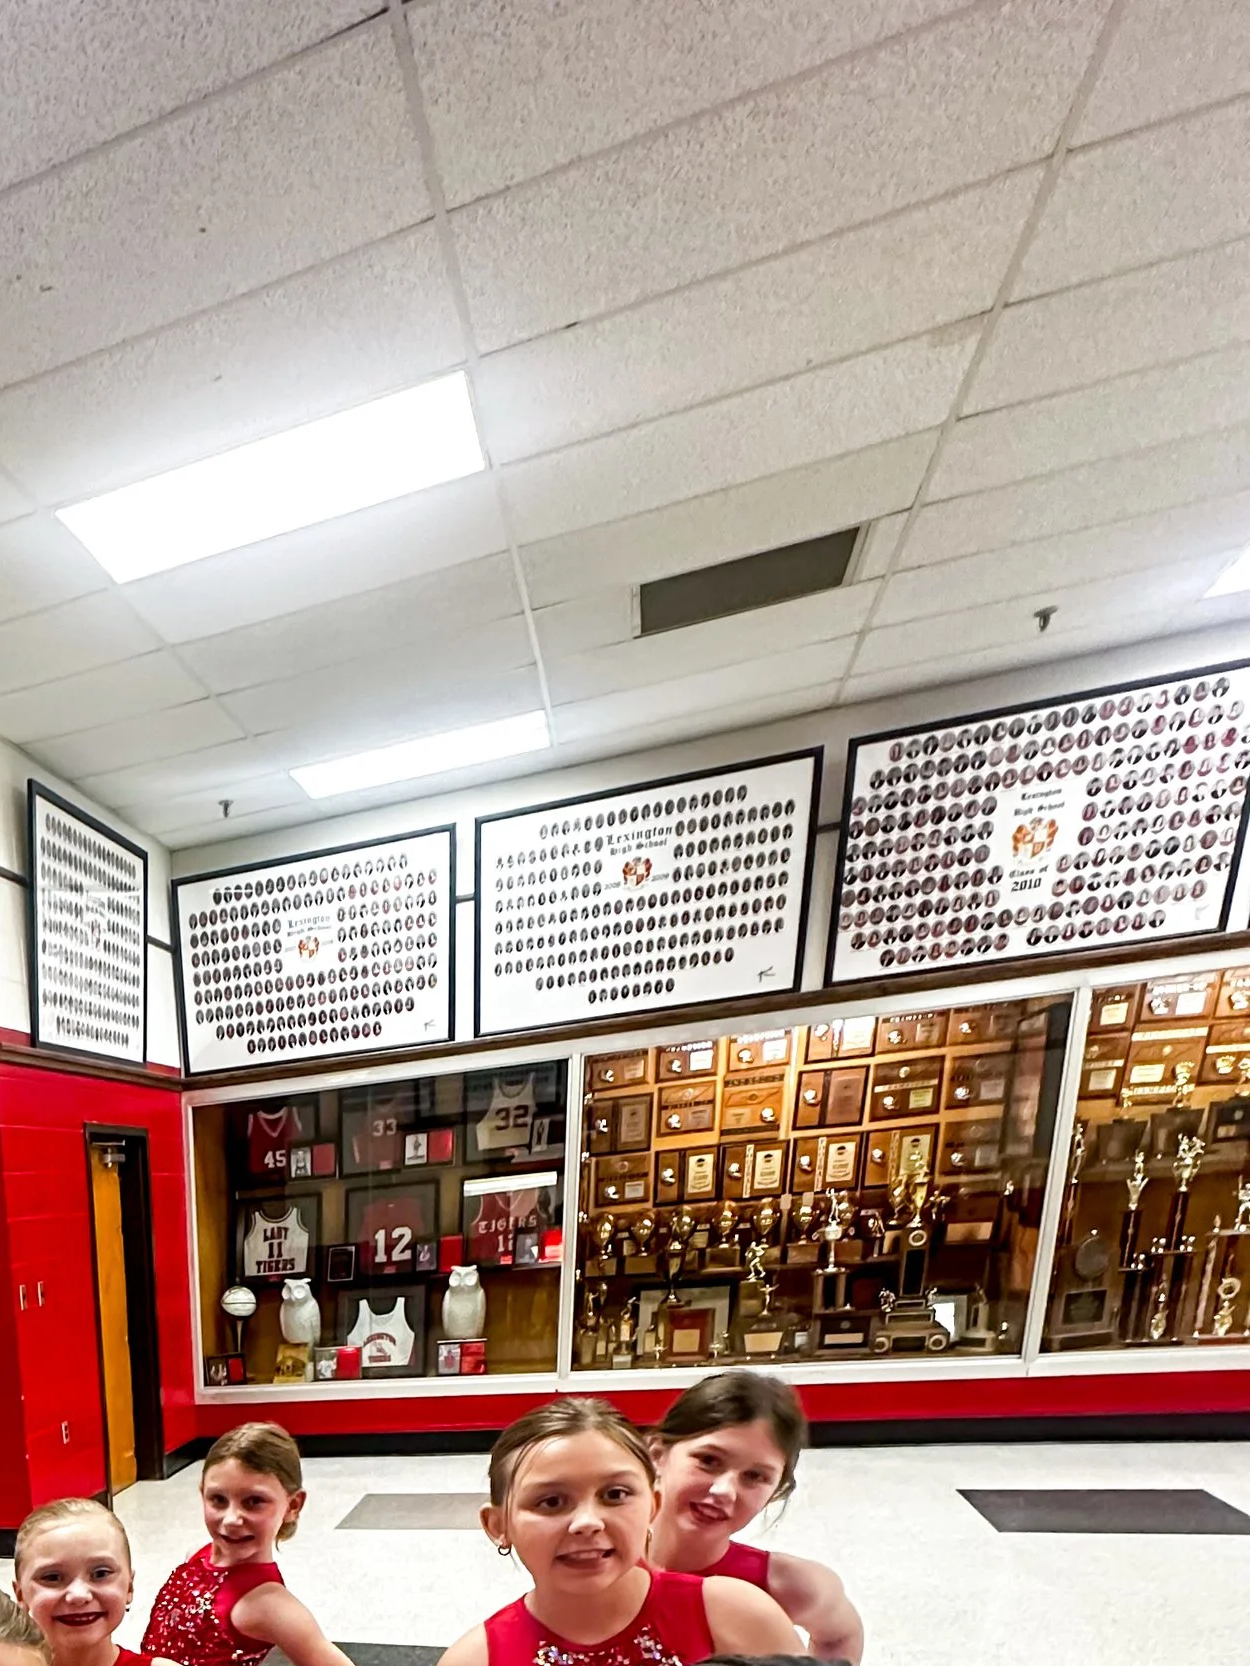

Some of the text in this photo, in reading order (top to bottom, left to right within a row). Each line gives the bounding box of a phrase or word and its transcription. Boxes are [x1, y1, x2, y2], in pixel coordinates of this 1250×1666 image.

[606, 826, 672, 846] Lexington
[1011, 877, 1042, 892] 2010
[372, 1117, 397, 1137] 33
[494, 1104, 530, 1131] 32
[263, 1150, 287, 1168] 45
[268, 1241, 284, 1259] 11
[374, 1226, 412, 1264] 12
[255, 1257, 296, 1274] TIGERS
